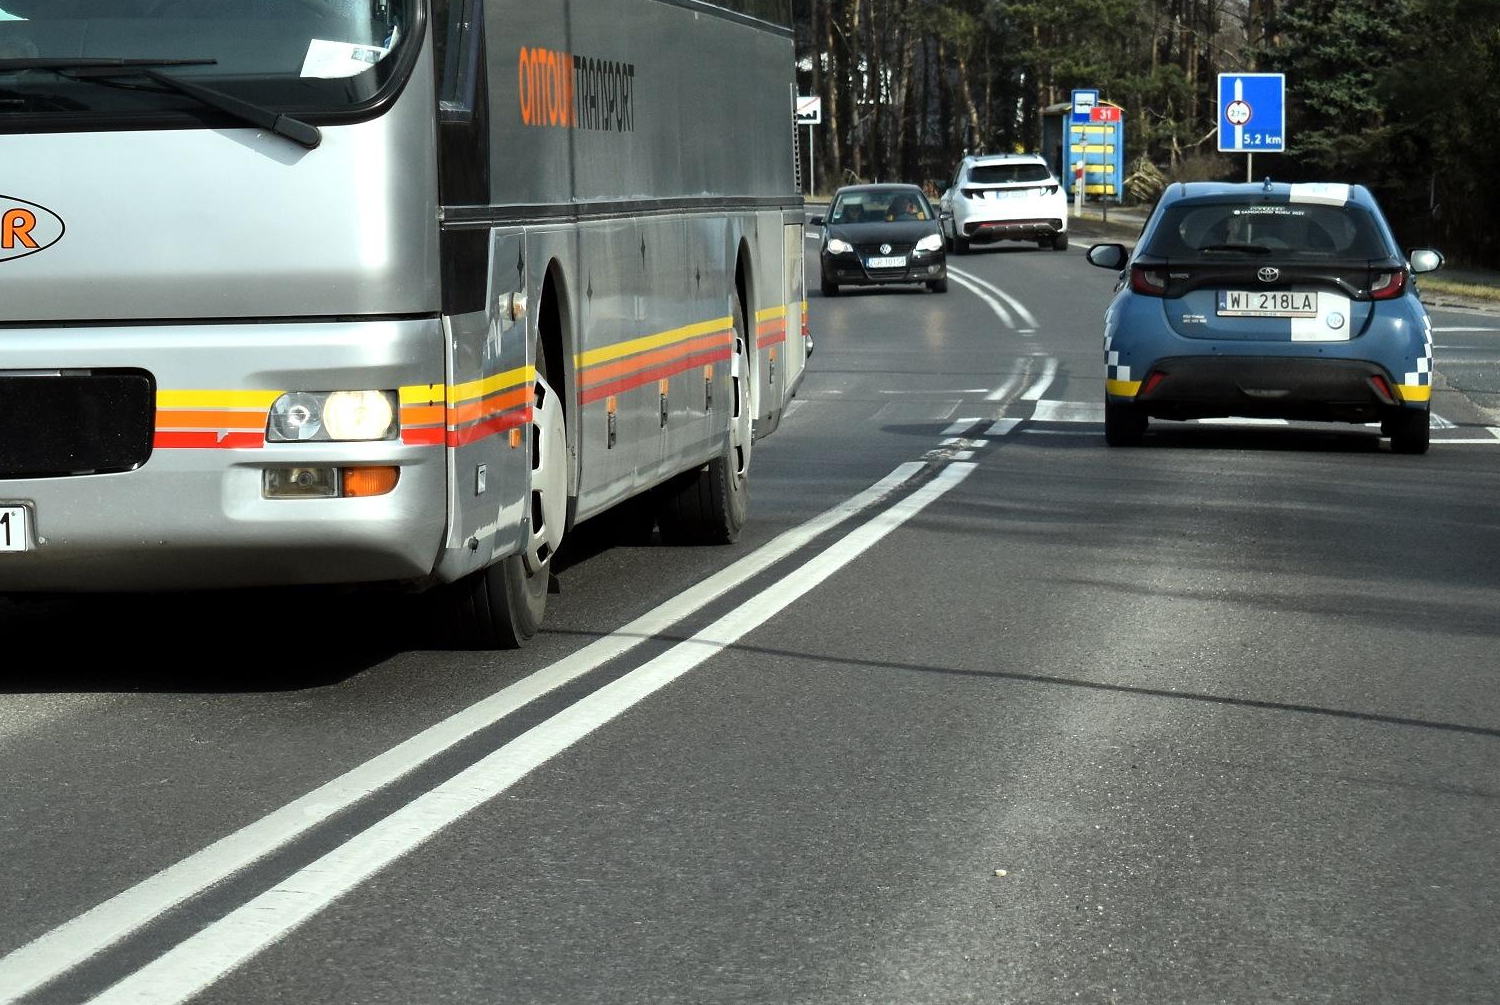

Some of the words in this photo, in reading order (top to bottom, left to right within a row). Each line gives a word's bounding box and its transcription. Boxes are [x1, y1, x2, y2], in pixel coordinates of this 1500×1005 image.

[1099, 108, 1113, 120] 31
[1265, 134, 1282, 145] km
[1231, 294, 1249, 310] WI
[1259, 294, 1312, 310] 218LA
